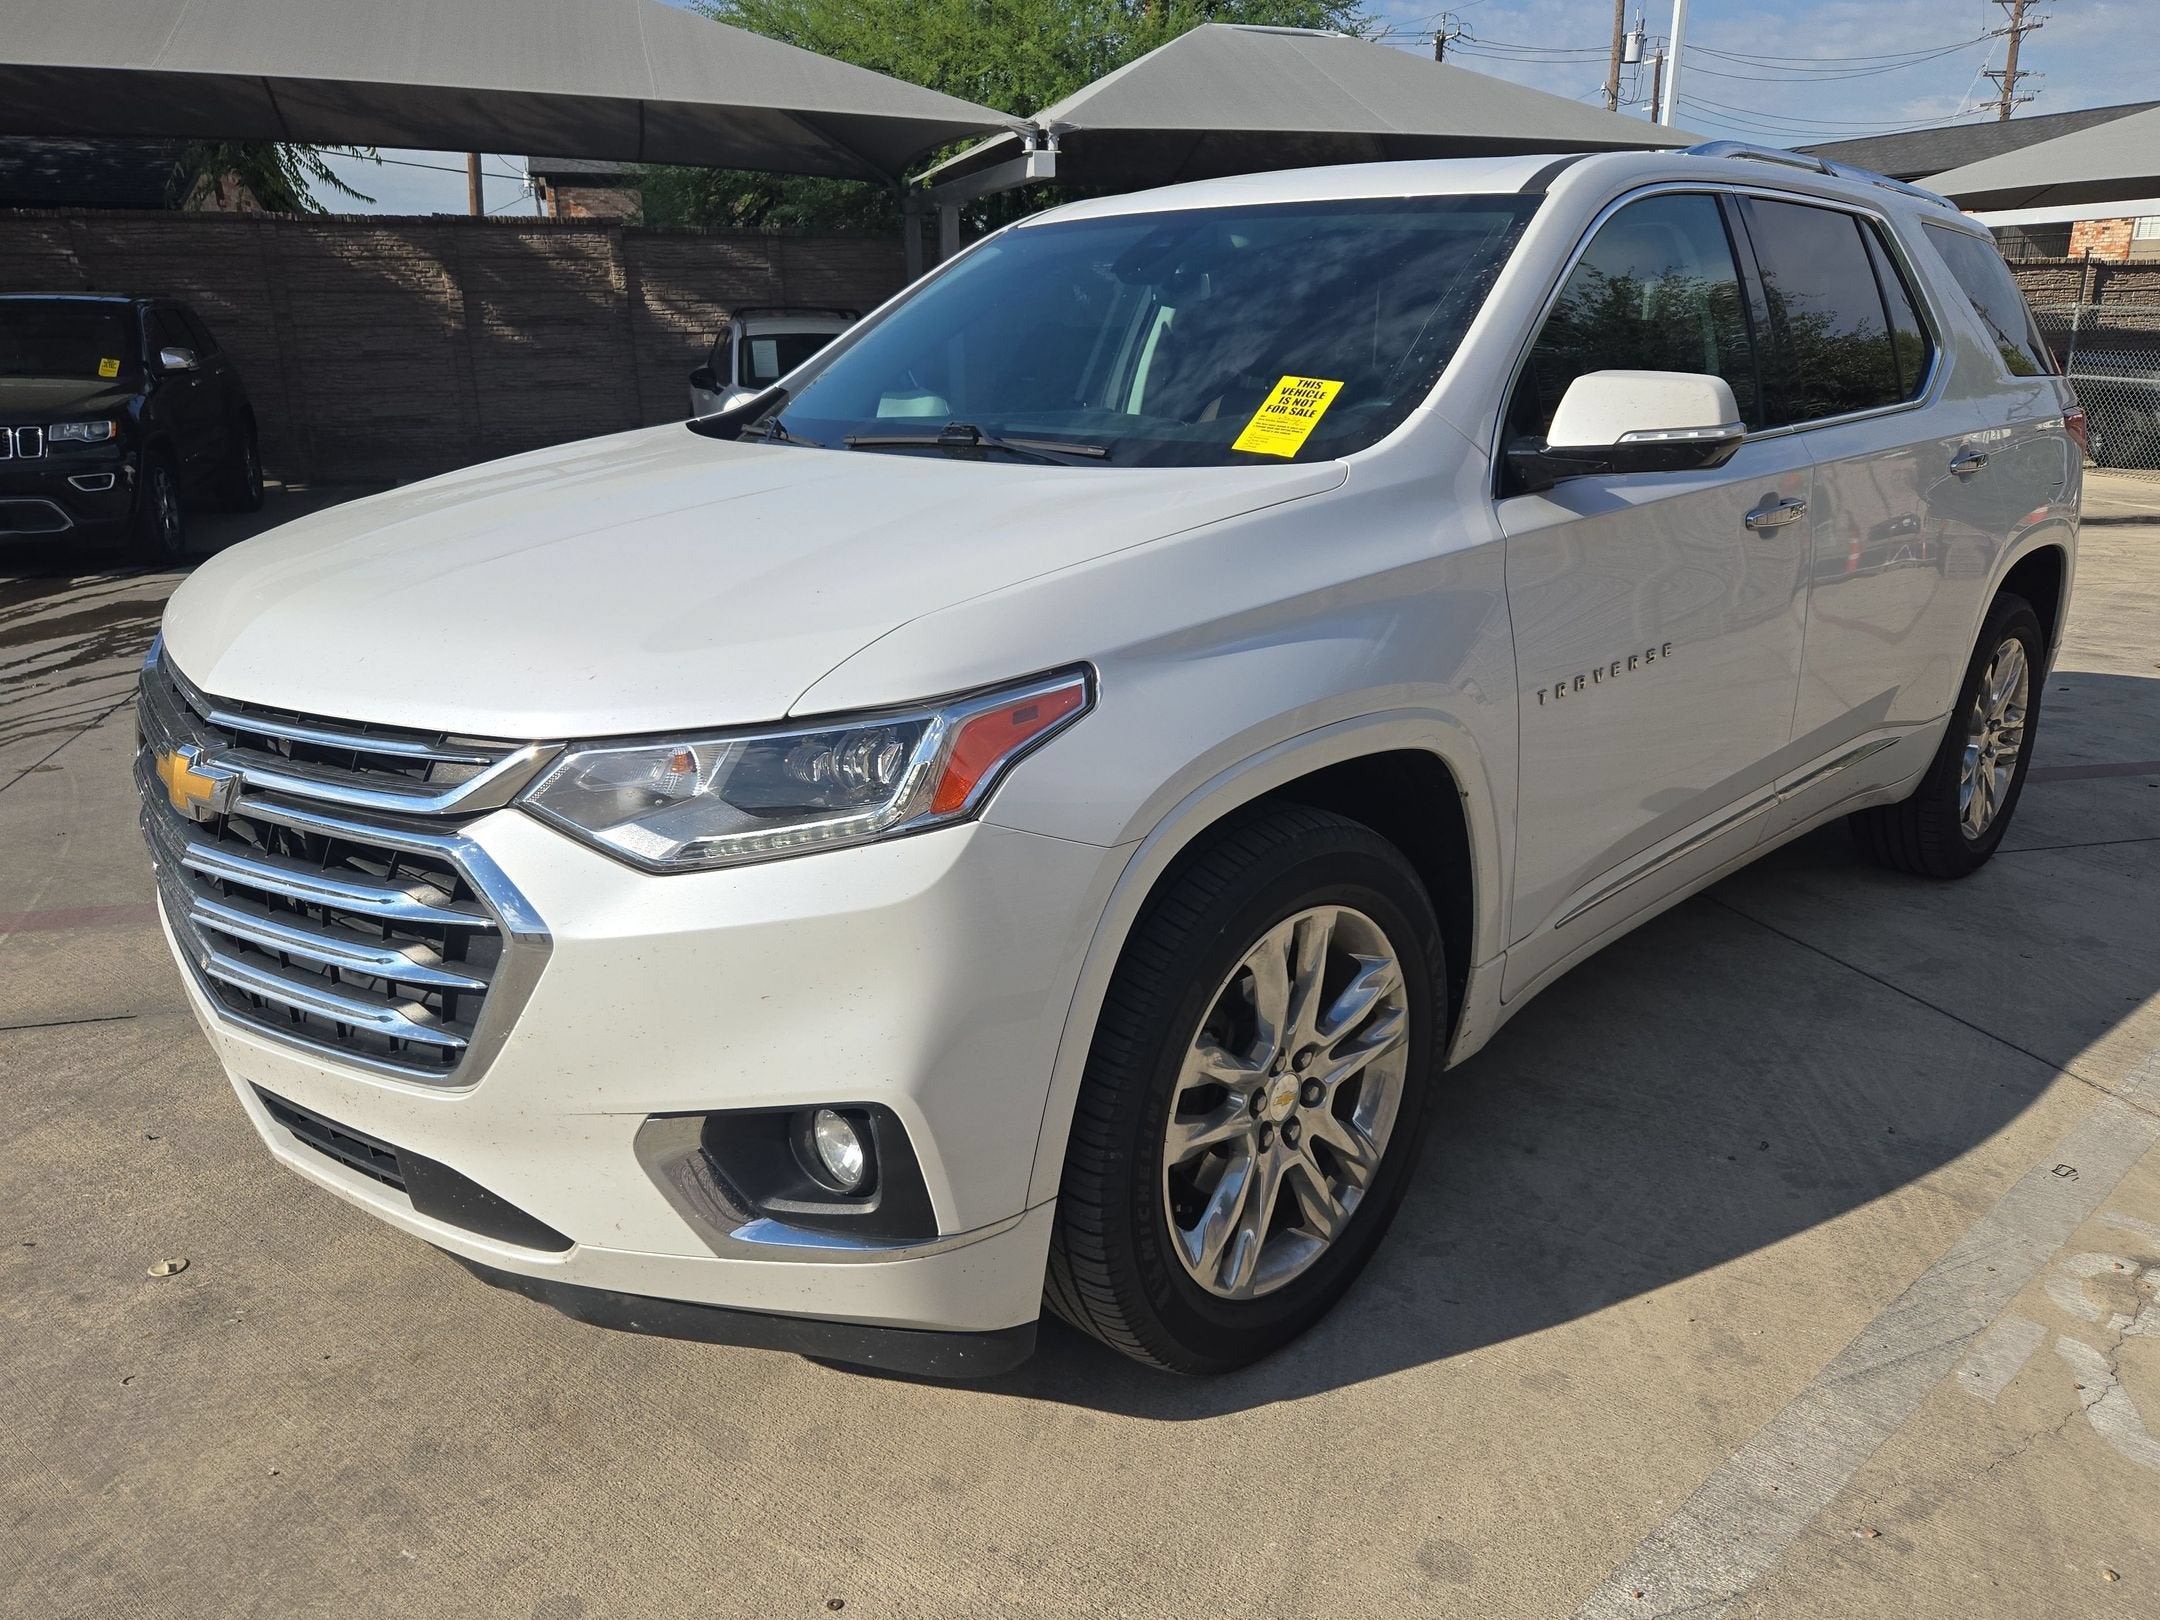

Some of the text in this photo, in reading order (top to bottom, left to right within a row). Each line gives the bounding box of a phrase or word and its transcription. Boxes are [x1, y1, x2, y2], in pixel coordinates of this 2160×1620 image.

[1297, 380, 1323, 389] THIS
[1281, 387, 1327, 399] VEHICLE
[1278, 396, 1317, 408] IS NOT
[1265, 405, 1317, 418] FOR SALE
[1537, 642, 1672, 705] TRAVERSE
[1134, 1100, 1160, 1262] MICHELIN
